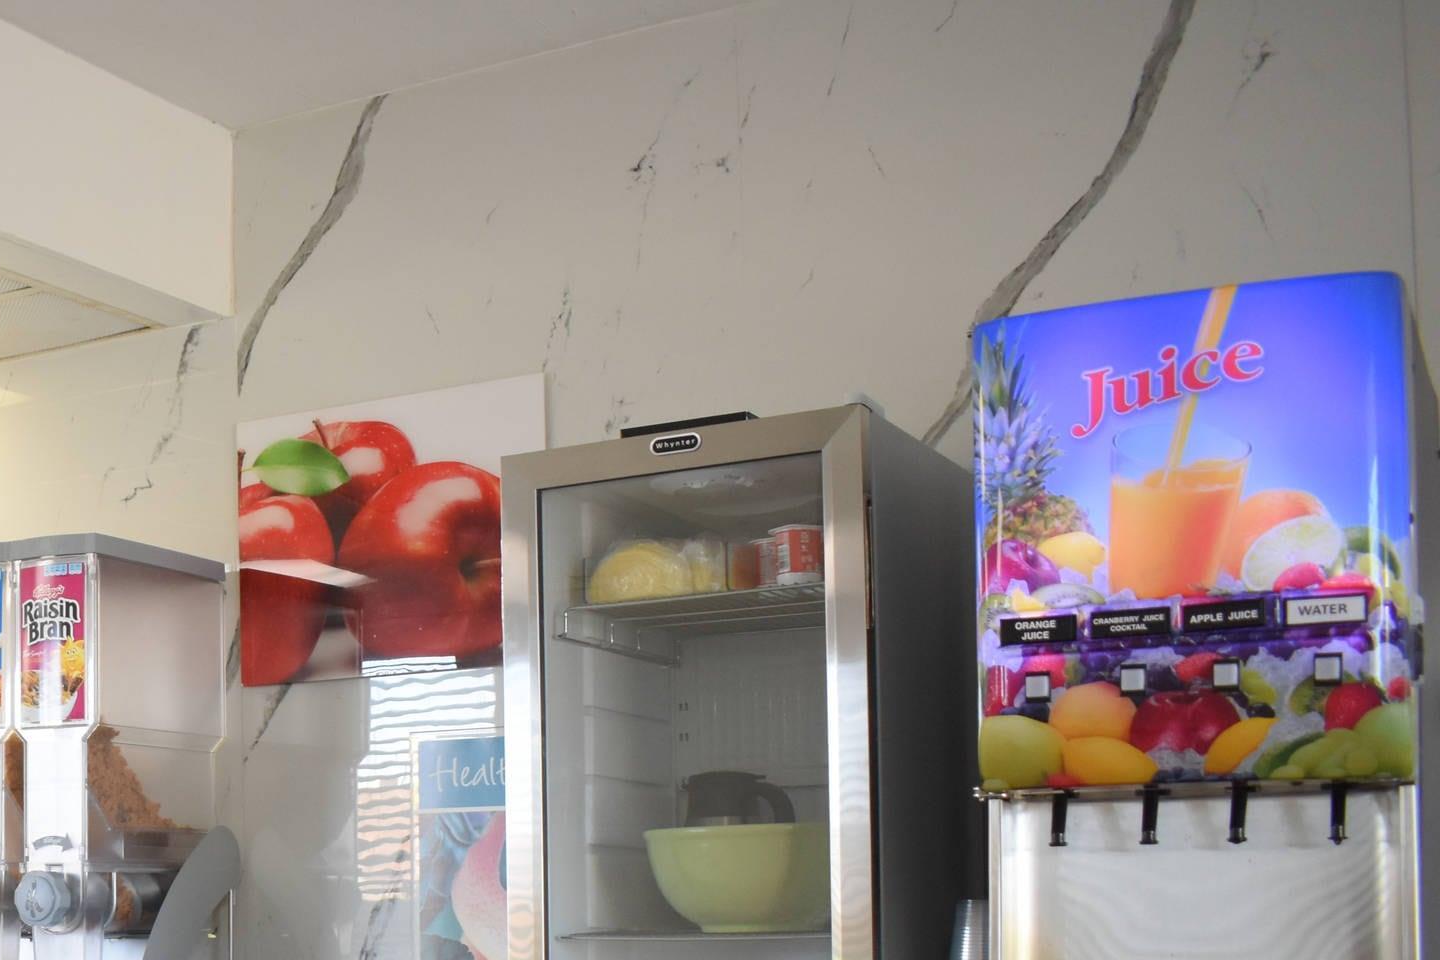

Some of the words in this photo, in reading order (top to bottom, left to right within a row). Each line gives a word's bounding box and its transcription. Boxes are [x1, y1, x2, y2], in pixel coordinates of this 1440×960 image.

[1071, 340, 1264, 439] Juice
[655, 438, 696, 449] Whynter
[22, 599, 80, 626] Raisin
[1297, 603, 1349, 617] WATER
[1092, 615, 1140, 626] CRANBERRY
[1141, 613, 1166, 623] JUICE
[1189, 612, 1224, 625] APPLE
[1227, 609, 1259, 621] JUICE
[28, 618, 72, 644] Bran
[1014, 619, 1057, 631] ORANGE
[1109, 623, 1148, 632] COCKTAIL
[1020, 631, 1051, 641] JUICE
